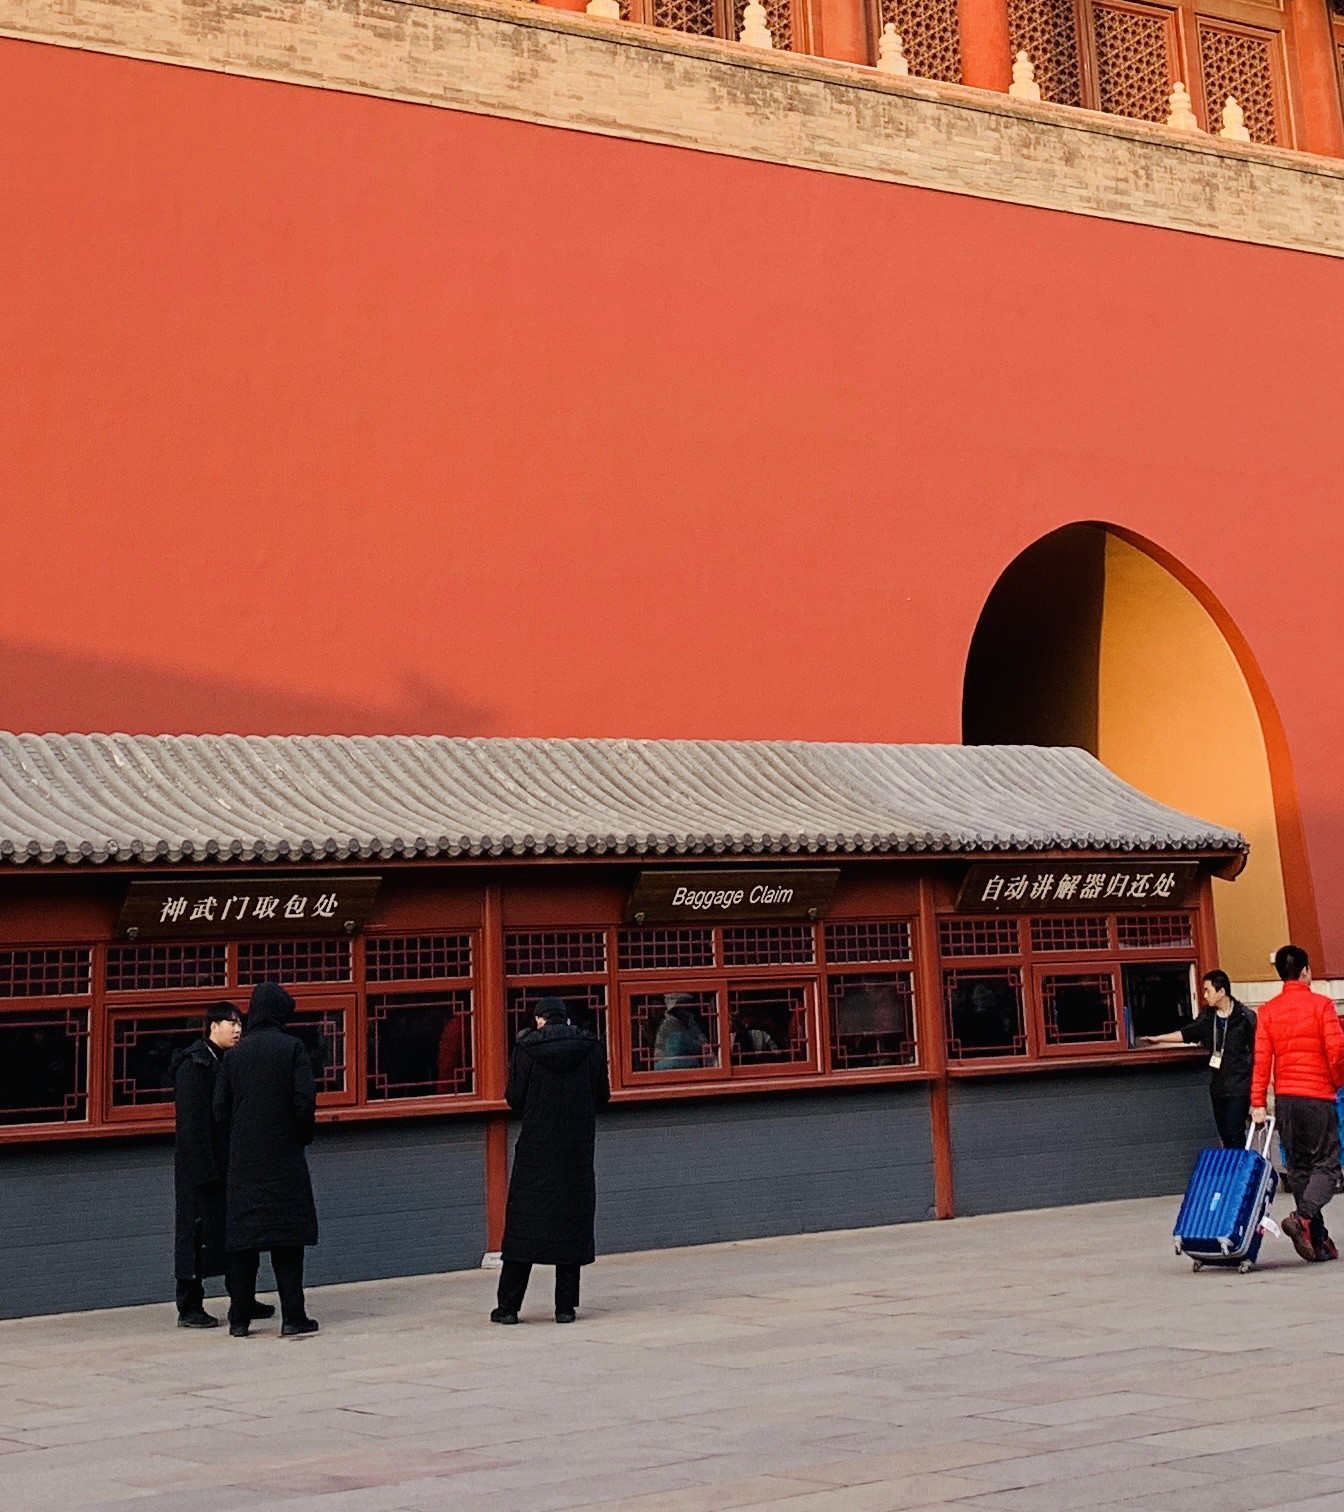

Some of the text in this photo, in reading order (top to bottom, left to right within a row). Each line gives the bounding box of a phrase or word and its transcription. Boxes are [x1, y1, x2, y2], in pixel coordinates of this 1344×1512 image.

[671, 884, 794, 910] Baggage Claim
[981, 872, 1176, 902] 自动讲解器归还处
[159, 892, 339, 923] 神武门取包处
